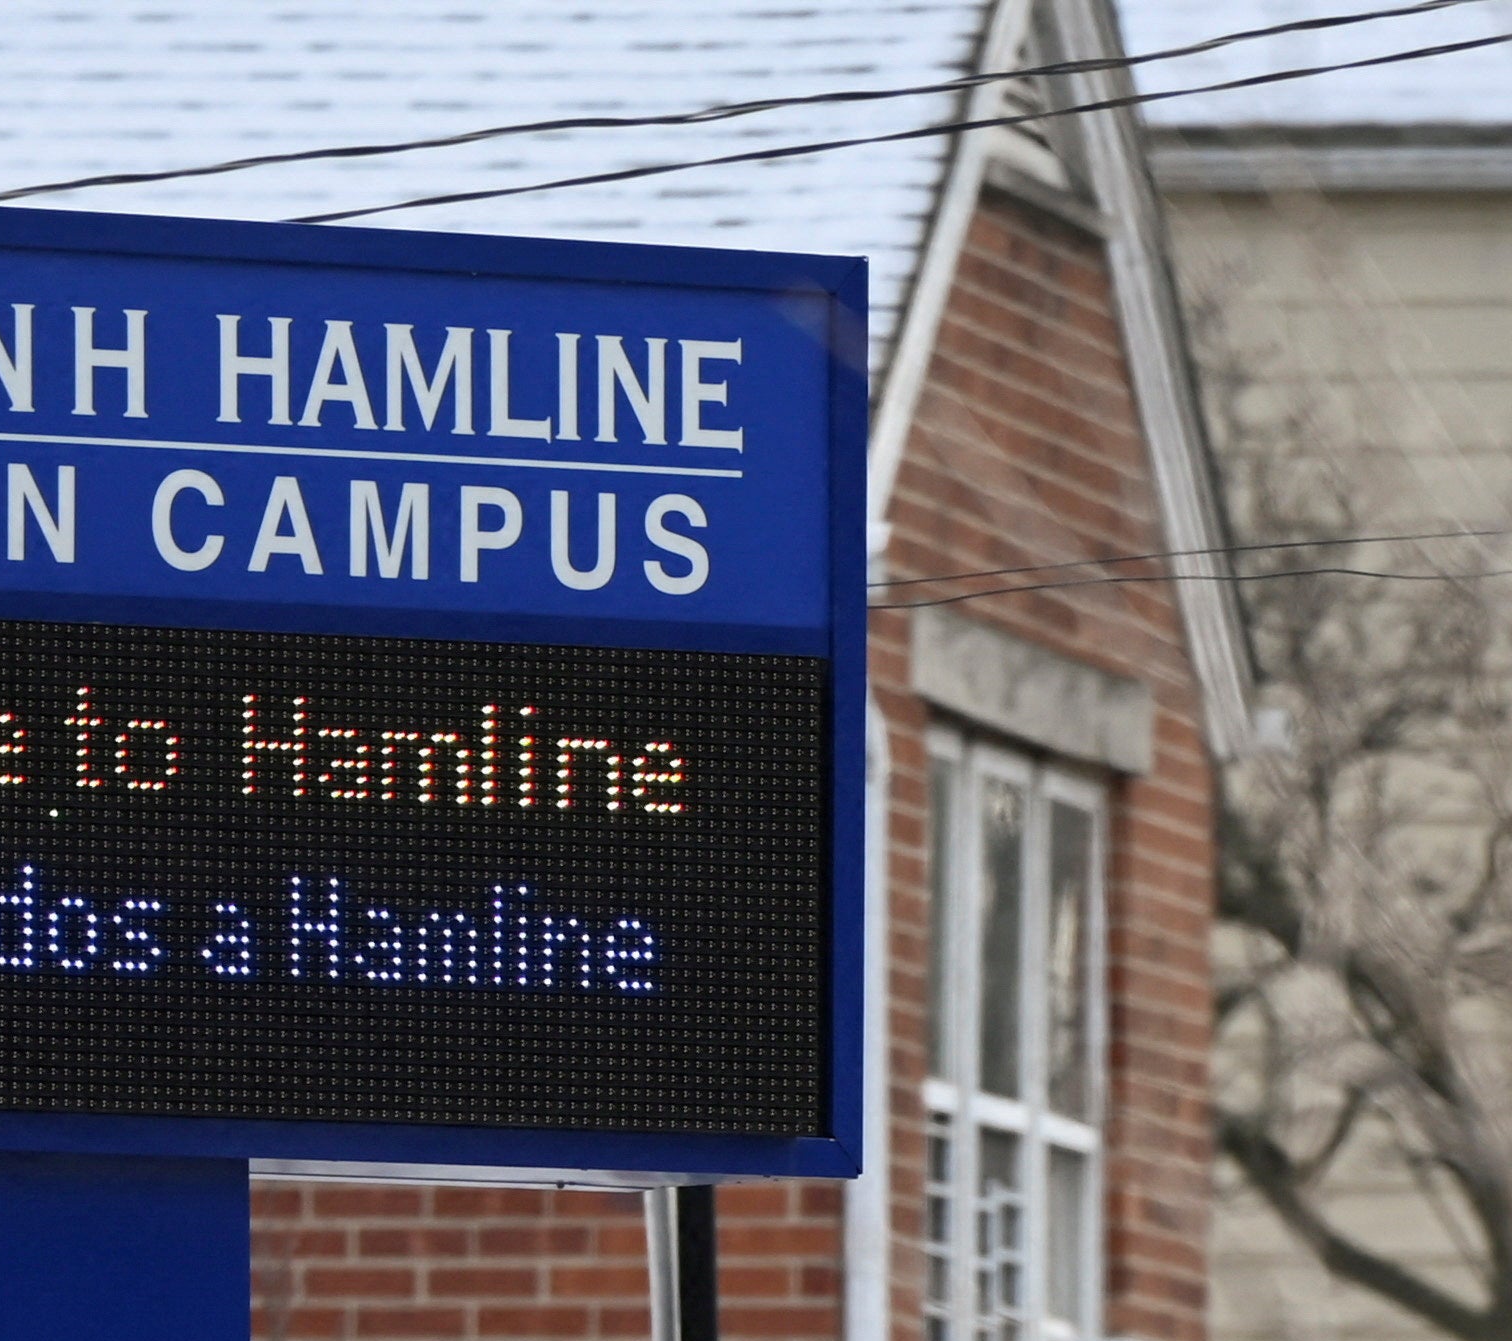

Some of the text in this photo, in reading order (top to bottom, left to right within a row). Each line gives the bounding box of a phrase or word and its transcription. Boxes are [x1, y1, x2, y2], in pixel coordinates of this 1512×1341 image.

[71, 305, 148, 418] H
[216, 313, 743, 453] HAMLINE
[150, 468, 711, 595] CAMPUS
[64, 687, 180, 791] to
[242, 691, 685, 812] Hamline
[201, 902, 253, 977] a
[290, 875, 654, 992] Hamline
